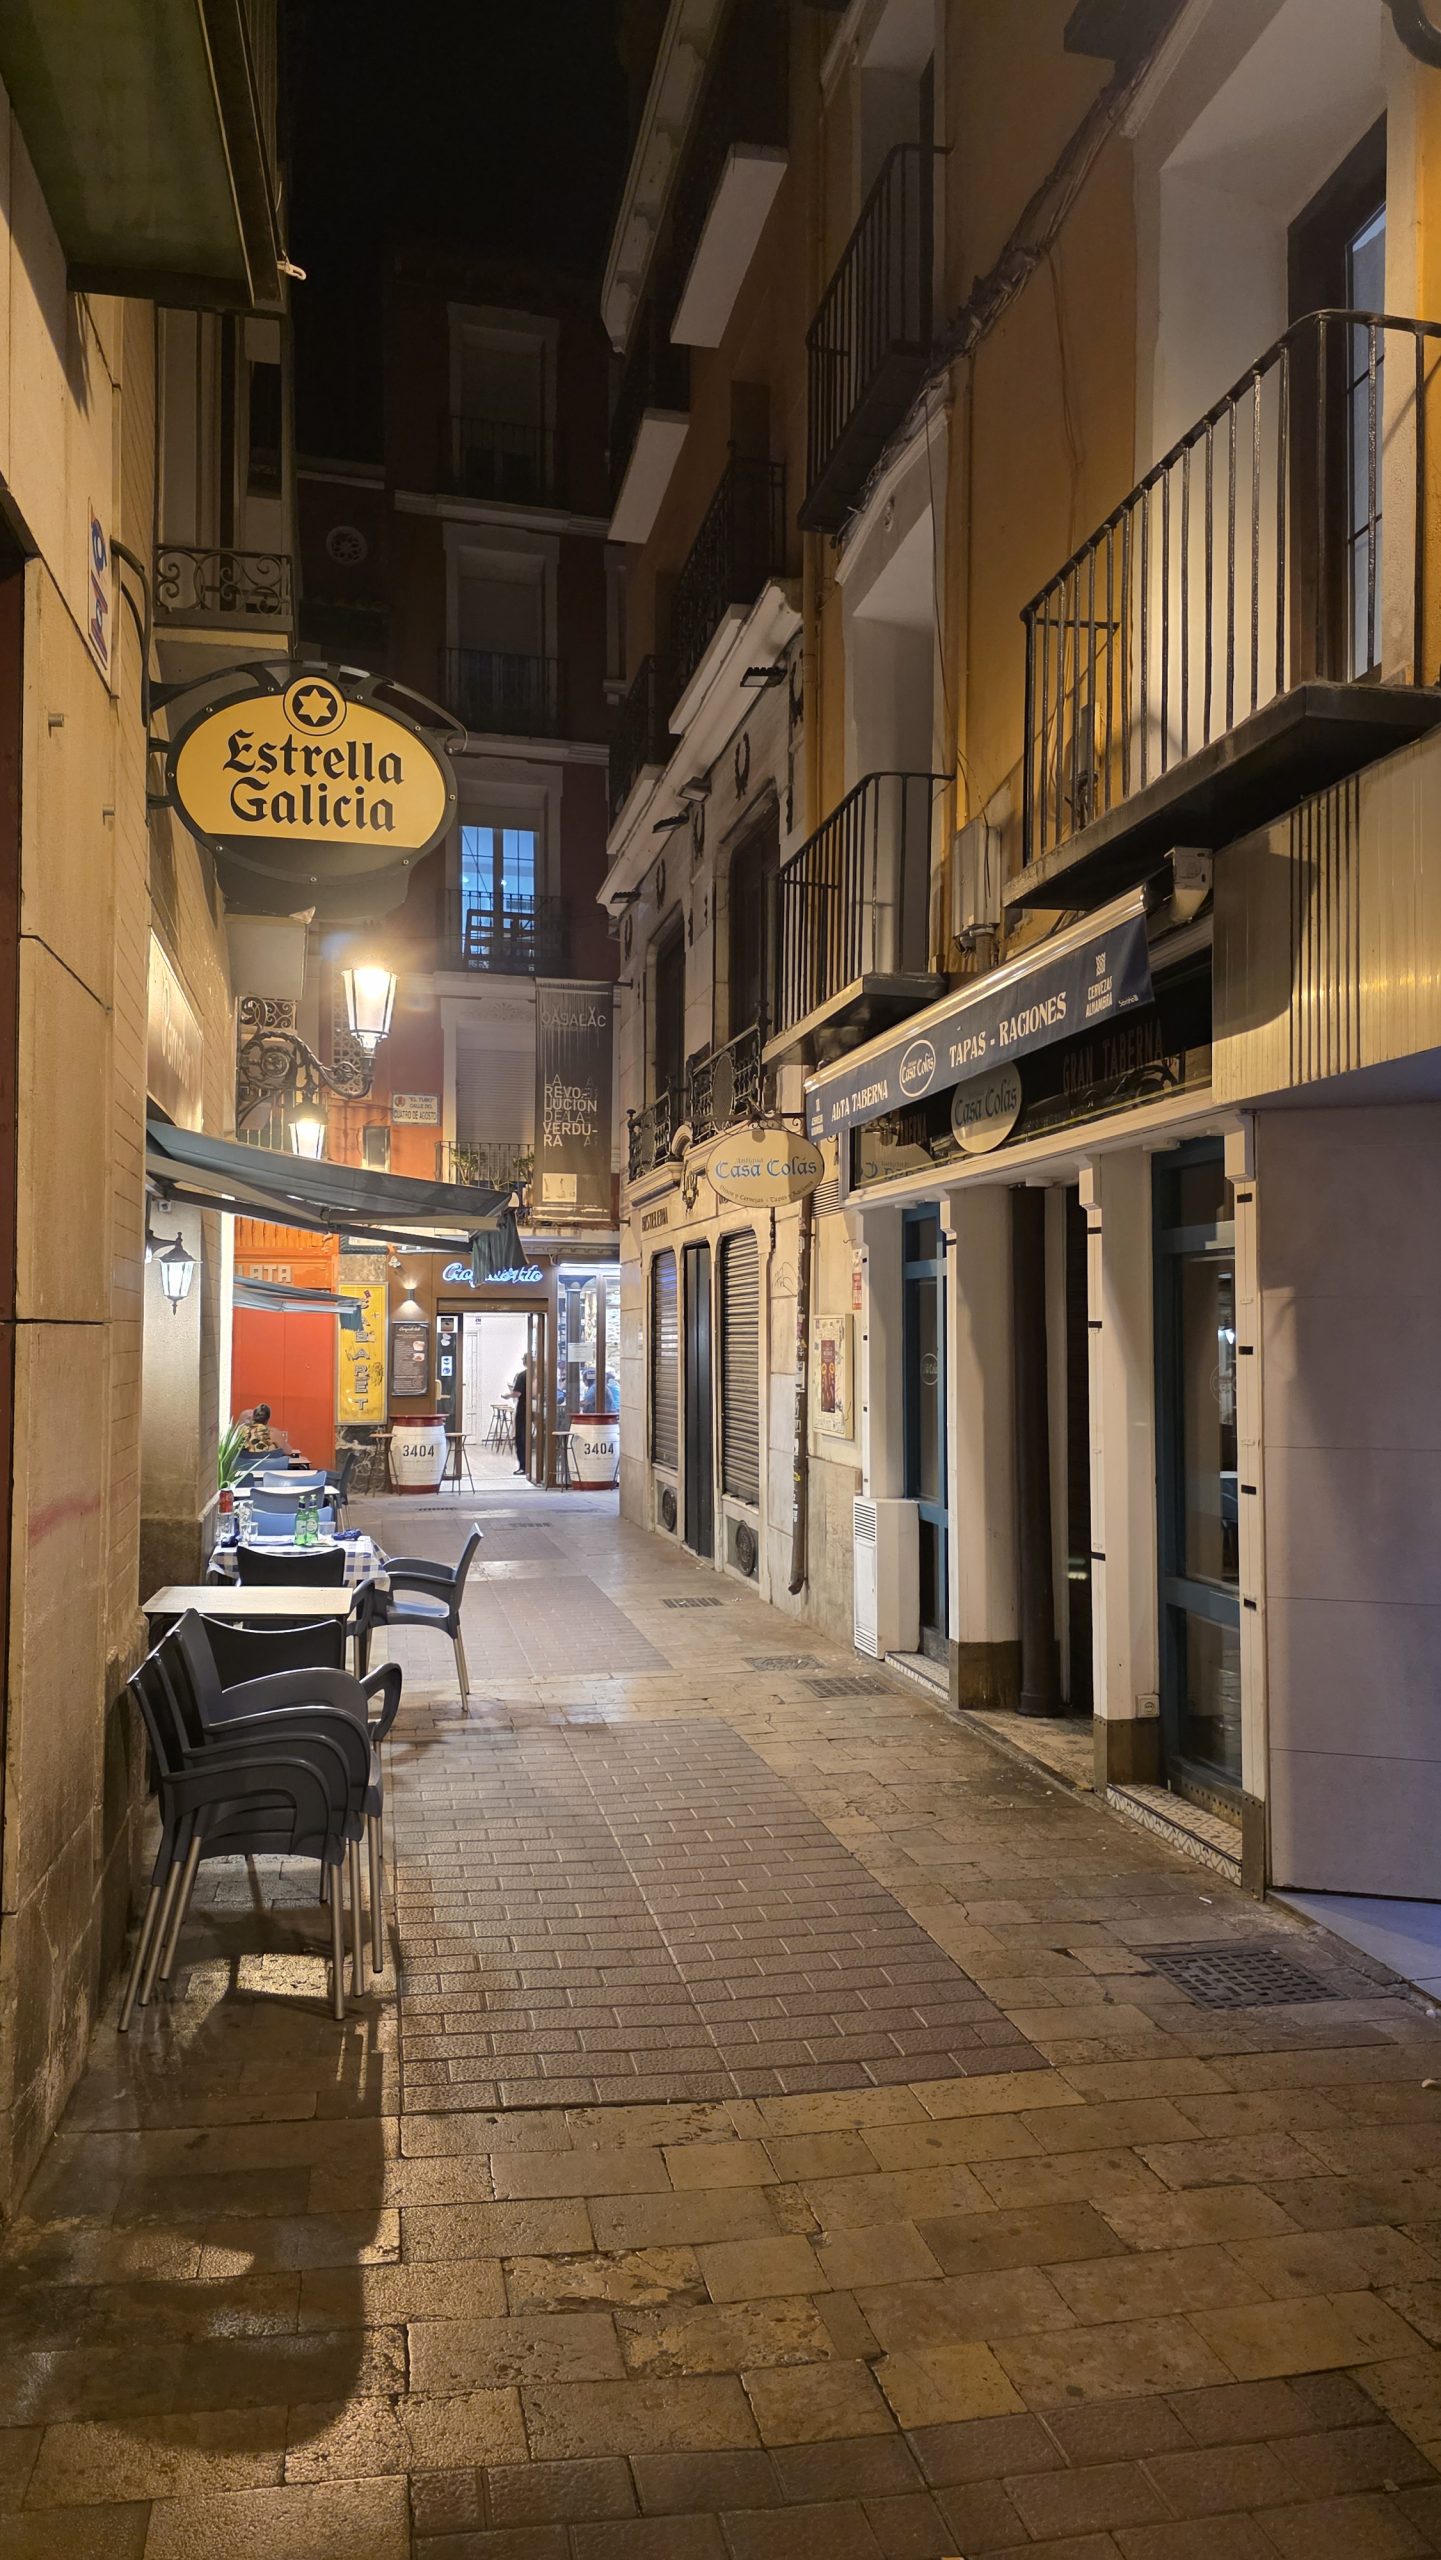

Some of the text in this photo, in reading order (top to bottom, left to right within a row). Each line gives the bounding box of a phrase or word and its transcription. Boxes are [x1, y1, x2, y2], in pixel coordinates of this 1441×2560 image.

[223, 729, 404, 785] Estrella
[230, 776, 396, 832] Galicia
[1087, 976, 1113, 1001] CERVEZAS
[1085, 992, 1113, 1018] ALHAMBRA
[949, 1031, 986, 1068] TAPAS
[999, 992, 1067, 1047] RACIONES
[1063, 1015, 1164, 1097] GRAN TABERNA
[831, 1098, 850, 1122] ALTA
[851, 1079, 888, 1112] TABERNA
[955, 1079, 1017, 1127] Casa Colás
[543, 1122, 598, 1135] VERDU-
[543, 1134, 563, 1147] RA
[715, 1156, 817, 1179] Casa Colás
[402, 1444, 435, 1458] 3404
[583, 1442, 614, 1455] 3404
